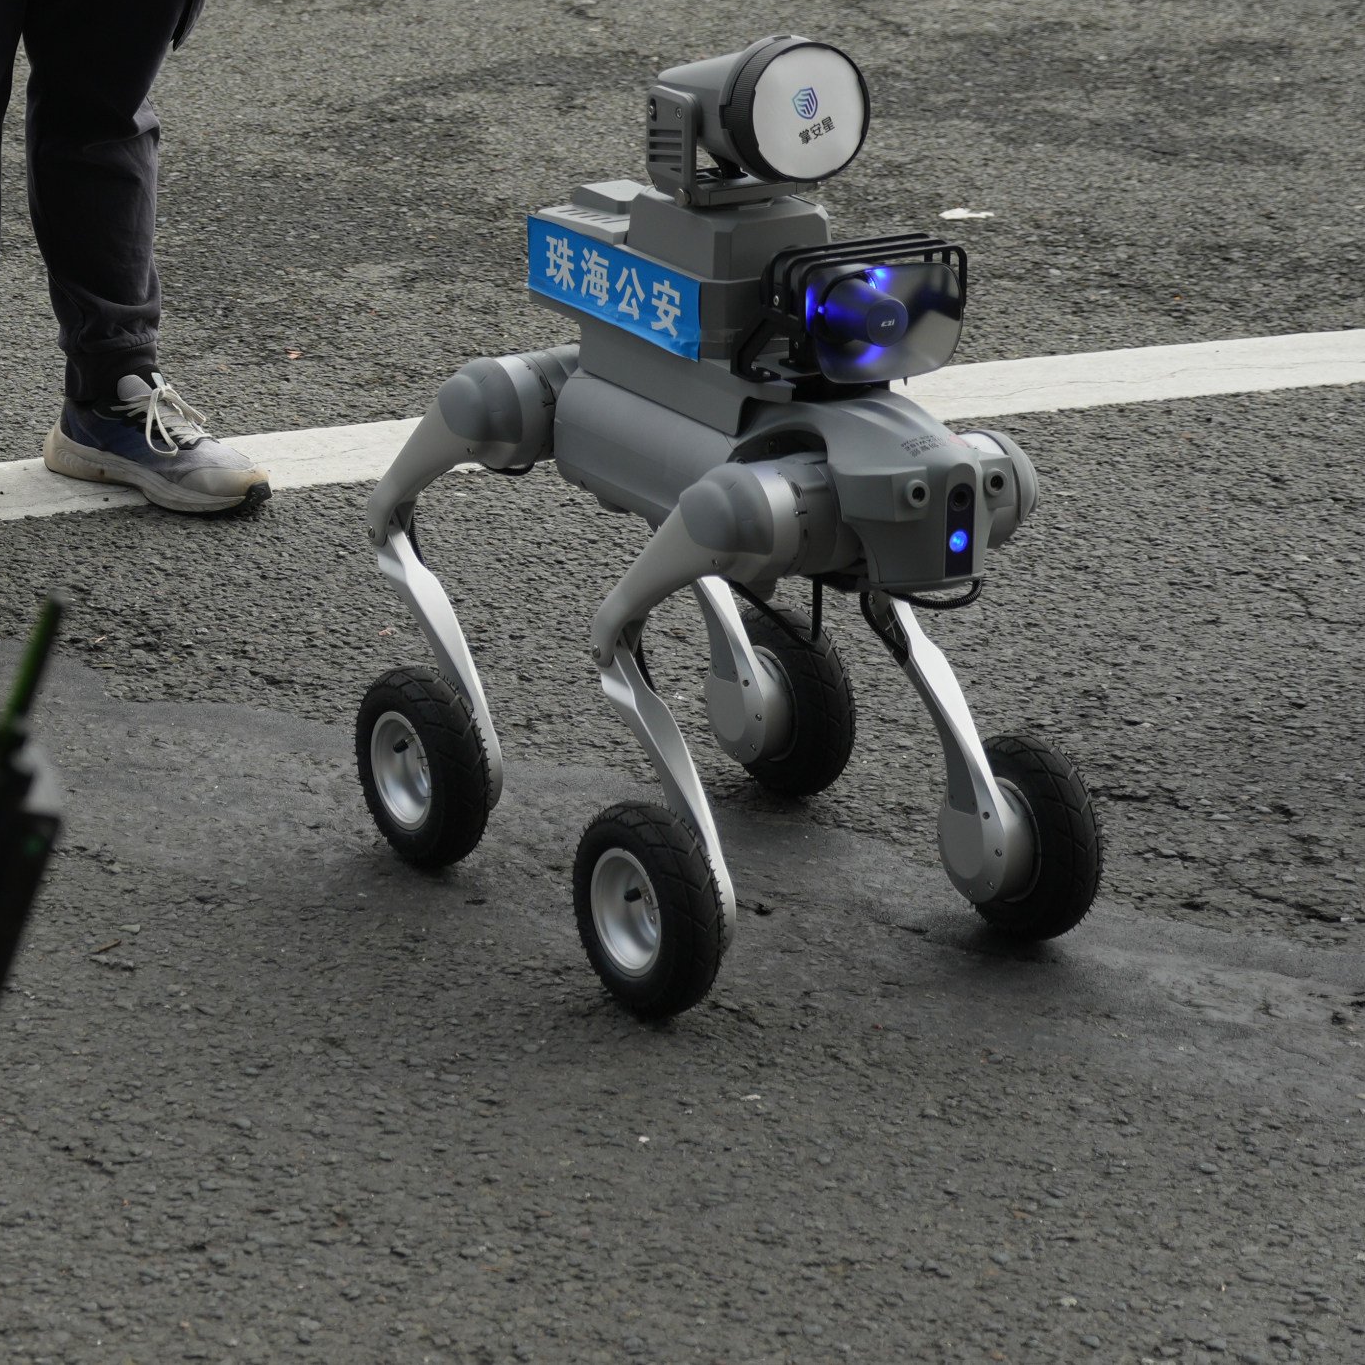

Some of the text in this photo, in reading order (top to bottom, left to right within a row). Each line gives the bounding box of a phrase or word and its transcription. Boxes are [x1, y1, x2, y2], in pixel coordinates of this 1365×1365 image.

[798, 116, 835, 144] 掌安星
[545, 235, 682, 340] 珠海公安
